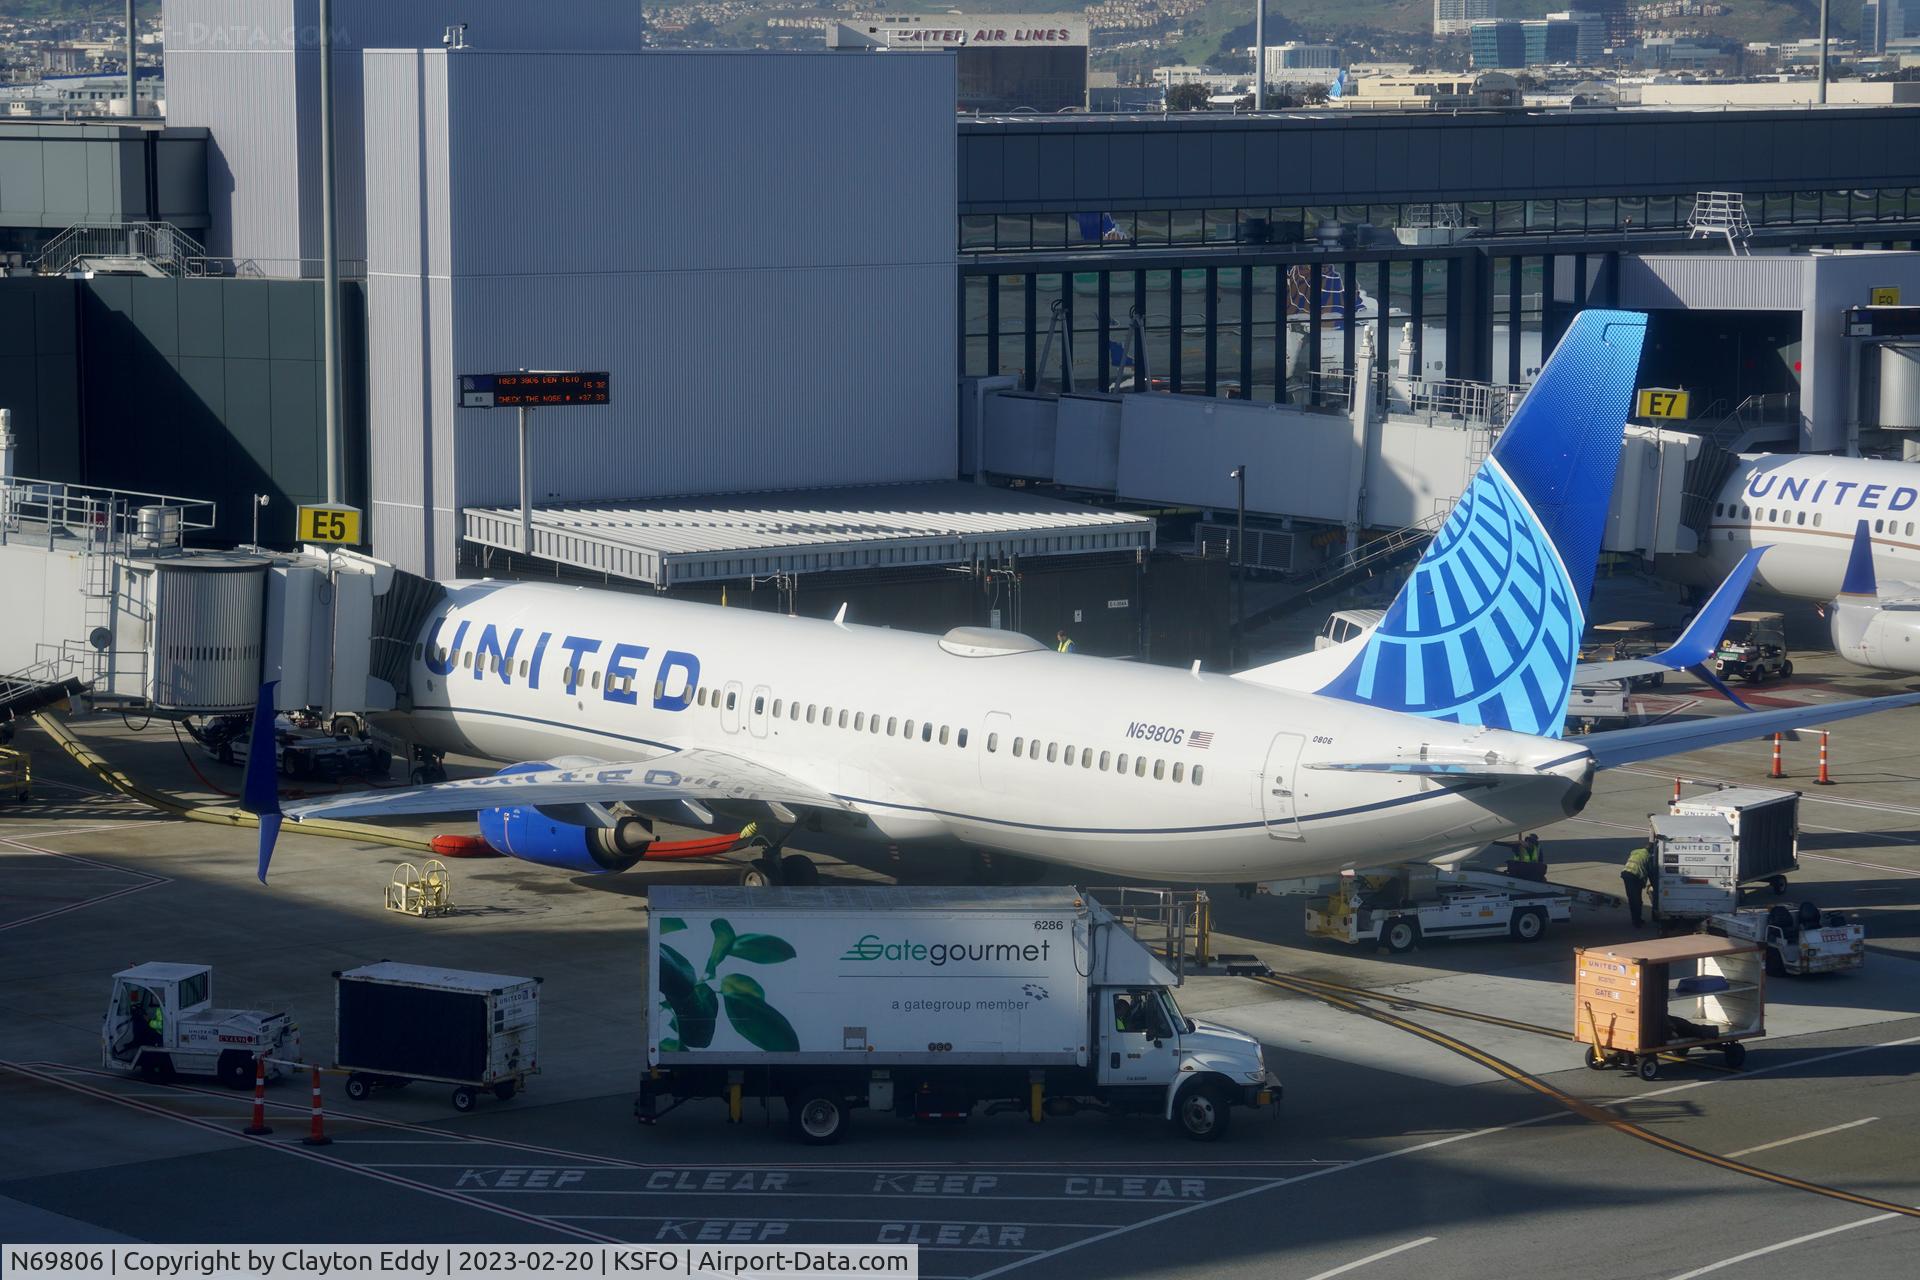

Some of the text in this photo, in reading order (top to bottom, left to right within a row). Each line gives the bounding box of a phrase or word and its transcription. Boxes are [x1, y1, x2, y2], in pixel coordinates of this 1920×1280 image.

[973, 29, 1008, 41] AIR
[1014, 29, 1070, 41] LINES
[1650, 393, 1677, 416] E7
[1748, 473, 1918, 511] UNITED
[313, 511, 345, 540] E5
[424, 616, 701, 712] UNITED
[1126, 721, 1185, 745] N69806
[1313, 736, 1333, 745] 0806
[1034, 920, 1064, 930] 6286
[1588, 961, 1617, 971] UNITED
[1595, 988, 1612, 999] GATE
[891, 999, 1029, 1012] a gategroup member
[455, 1169, 1206, 1197] KEEP CLEAR KEEP CLEAR
[655, 1221, 1026, 1246] KEEP CLEAR
